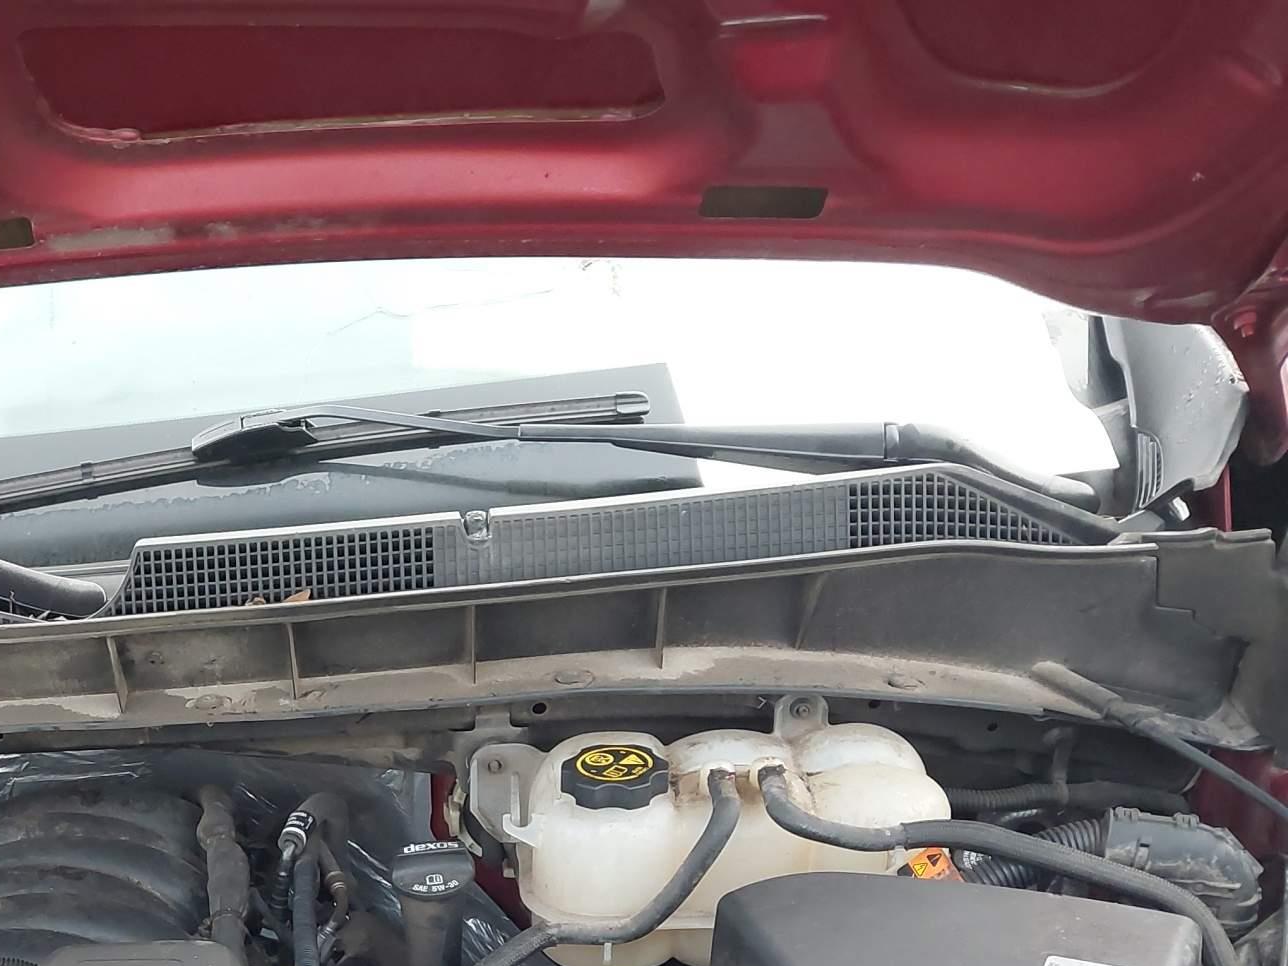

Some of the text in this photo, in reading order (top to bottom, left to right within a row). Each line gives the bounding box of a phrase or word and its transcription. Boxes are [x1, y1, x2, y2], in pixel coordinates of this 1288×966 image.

[403, 841, 459, 854] dexos
[412, 879, 459, 893] SAE 5W-30
